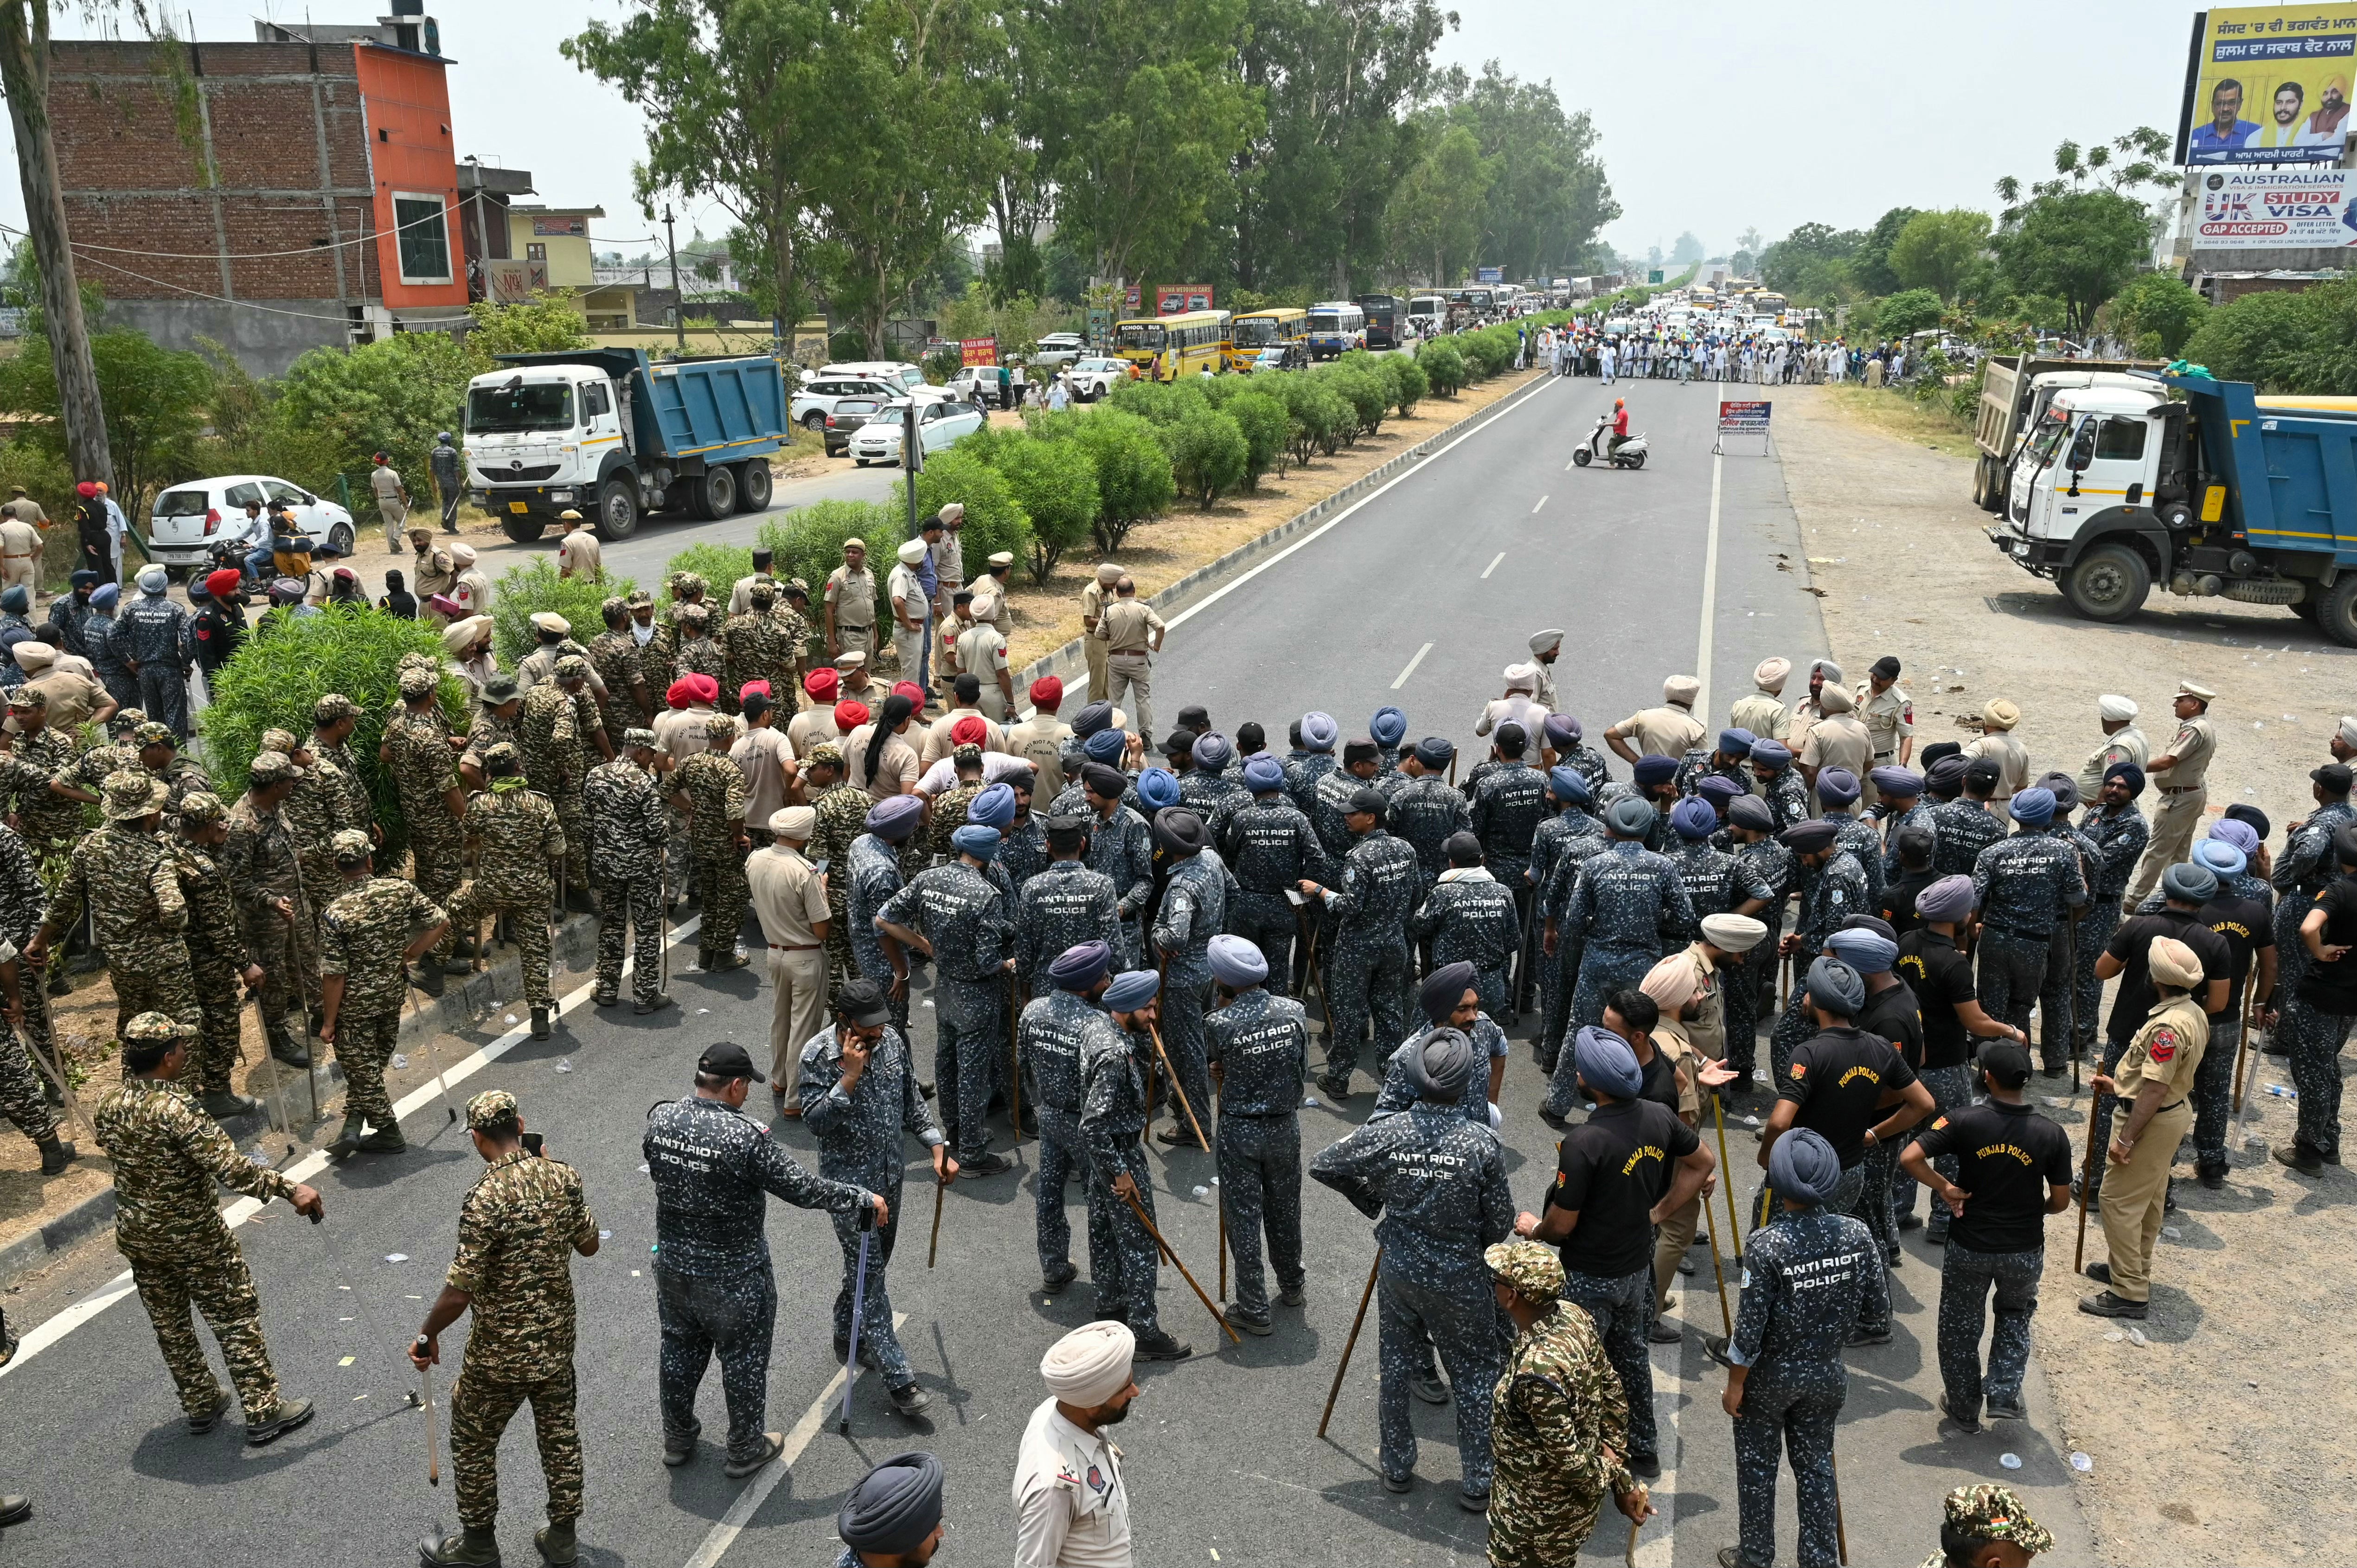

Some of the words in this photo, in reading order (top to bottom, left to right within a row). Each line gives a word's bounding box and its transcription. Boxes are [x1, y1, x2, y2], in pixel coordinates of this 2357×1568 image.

[2217, 21, 2246, 34] ਸੰਸਦ
[2268, 18, 2283, 32] ਵੀ
[2287, 16, 2330, 31] ਭਗਵੰਤ
[2250, 45, 2263, 55] ਦਾ
[2267, 43, 2301, 54] ਜਵਾਬ
[2305, 38, 2324, 52] ਵੋਟ
[2327, 40, 2353, 51] ਨਾਲ
[2254, 150, 2279, 158] ਆਦਮੀ
[2282, 148, 2304, 157] ਪਾਰਟੀ
[2230, 174, 2345, 184] AUSTRALIAN
[2267, 192, 2336, 204] STUDY
[2205, 193, 2257, 221] UK
[2267, 205, 2332, 217] VISA
[2203, 224, 2227, 234] GAP
[2229, 224, 2284, 233] ACCEPTED
[679, 728, 687, 739] ANTI
[820, 732, 832, 742] POLI
[854, 739, 863, 749] ANTI
[1023, 742, 1033, 755] ANTI
[879, 746, 888, 762] OLICE
[1593, 768, 1603, 779] RIO
[946, 775, 957, 789] ANTI
[1587, 779, 1602, 791] POLIC
[1067, 805, 1091, 815] ANTI
[1505, 799, 1538, 807] POLICE
[1939, 826, 1963, 836] ANTI
[1965, 831, 1991, 841] RIOT
[1945, 837, 1981, 850] POLICE
[1152, 846, 1164, 862] PUNJ
[1373, 864, 1390, 874] ANTI
[1391, 860, 1411, 870] RIOT
[1767, 872, 1780, 883] ANTI
[1780, 865, 1788, 876] RIO
[1378, 871, 1406, 883] POLICE
[1698, 874, 1726, 882] RIOT
[921, 889, 944, 901] ANTI
[945, 895, 968, 906] RIOT
[1037, 895, 1065, 904] ANTI
[1067, 894, 1095, 903] RIOT
[1483, 899, 1506, 908] RIOT
[925, 901, 958, 915] POLICE
[2227, 921, 2250, 938] POLICE
[1898, 954, 1919, 967] PUNJAB
[1916, 959, 1926, 979] POLICE
[1028, 1026, 1056, 1039] ANTI
[1057, 1032, 1081, 1046] RIO
[1233, 1030, 1265, 1045] ANTI
[1267, 1022, 1296, 1037] RIOT
[1035, 1040, 1076, 1057] POLICE
[1243, 1037, 1292, 1056] POLICE
[1838, 1066, 1857, 1088] PUNJAB
[1858, 1066, 1879, 1084] POLICE
[652, 1135, 684, 1152] ANTI
[684, 1145, 722, 1160] RIOT
[1976, 1143, 2005, 1159] PUNJAB
[2006, 1144, 2033, 1166] POLICE
[660, 1152, 711, 1172] POLICE
[1388, 1151, 1425, 1163] ANTI
[1429, 1154, 1466, 1167] RIOT
[1622, 1146, 1643, 1176] PUNJAB
[1644, 1145, 1665, 1163] POLICE
[1397, 1167, 1454, 1180] POLICE
[1782, 1260, 1820, 1277] ANTI
[1821, 1252, 1862, 1269] RIOT
[1793, 1271, 1851, 1291] POLICE
